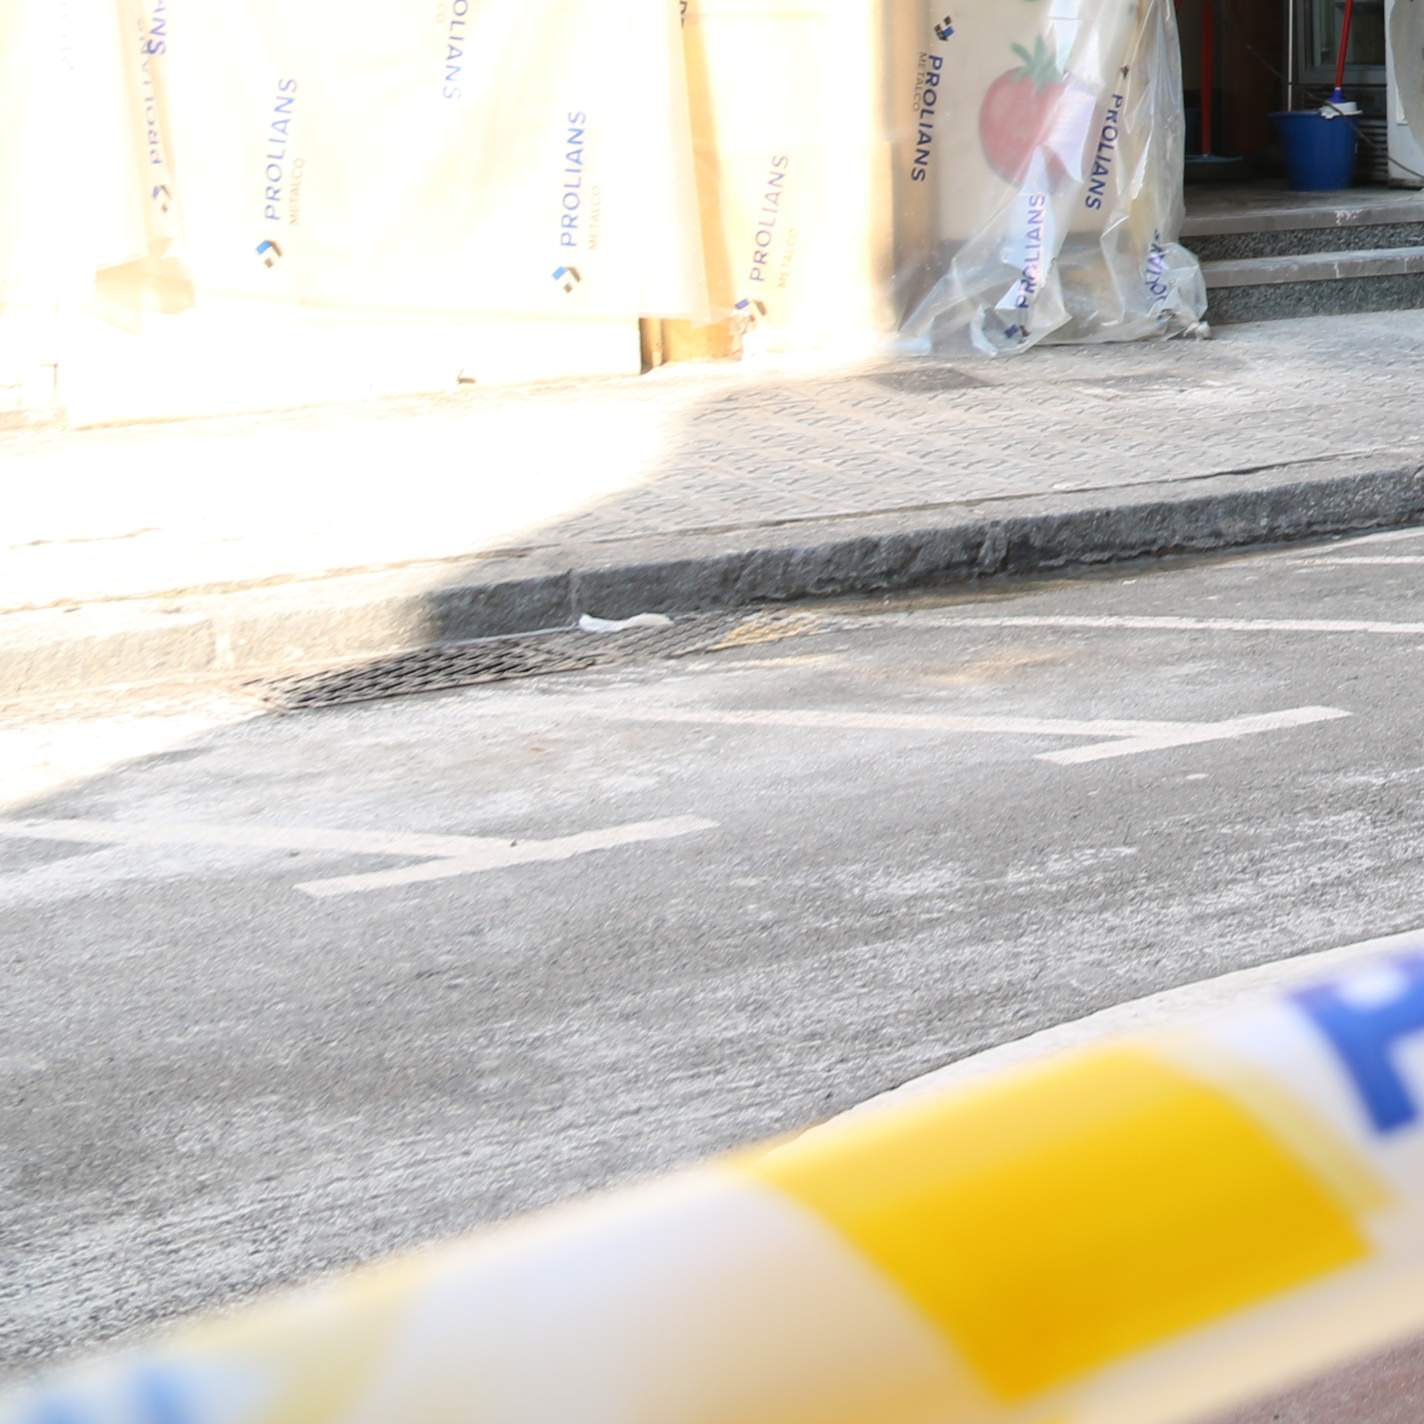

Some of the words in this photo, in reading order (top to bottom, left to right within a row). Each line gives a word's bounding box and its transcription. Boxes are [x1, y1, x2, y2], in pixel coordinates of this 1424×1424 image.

[264, 77, 298, 222] PROLIANS
[559, 110, 587, 248] PROLIANS
[911, 54, 944, 183] PROLIANS
[1085, 93, 1124, 211] PROLIANS
[748, 153, 791, 283] PROLIANS
